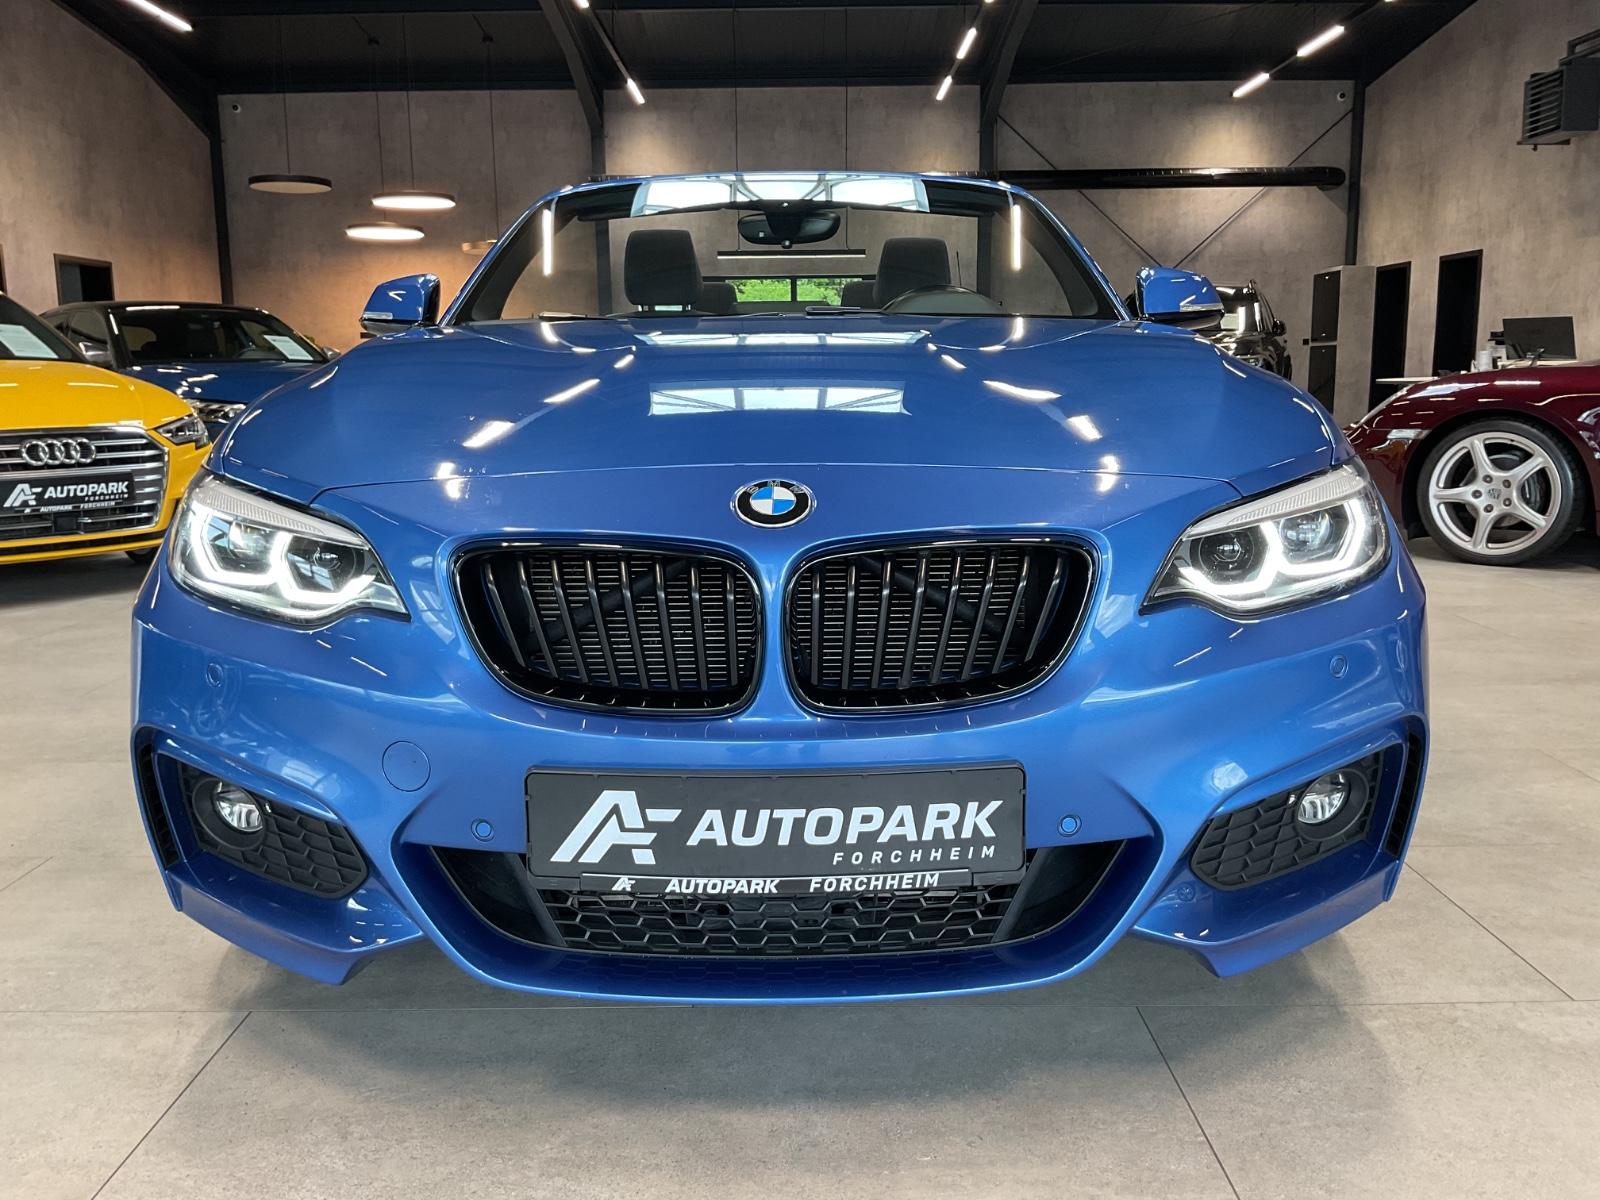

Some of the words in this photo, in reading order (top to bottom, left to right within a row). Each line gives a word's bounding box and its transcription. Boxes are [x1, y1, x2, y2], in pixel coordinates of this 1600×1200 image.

[44, 481, 129, 499] AUTOPARK
[40, 504, 73, 513] AUTOPARK
[686, 801, 1004, 846] AUTOPARK
[833, 845, 995, 865] FORCHHEIM
[665, 878, 780, 894] AUTOPARK
[809, 872, 939, 893] FORCHHEIM
